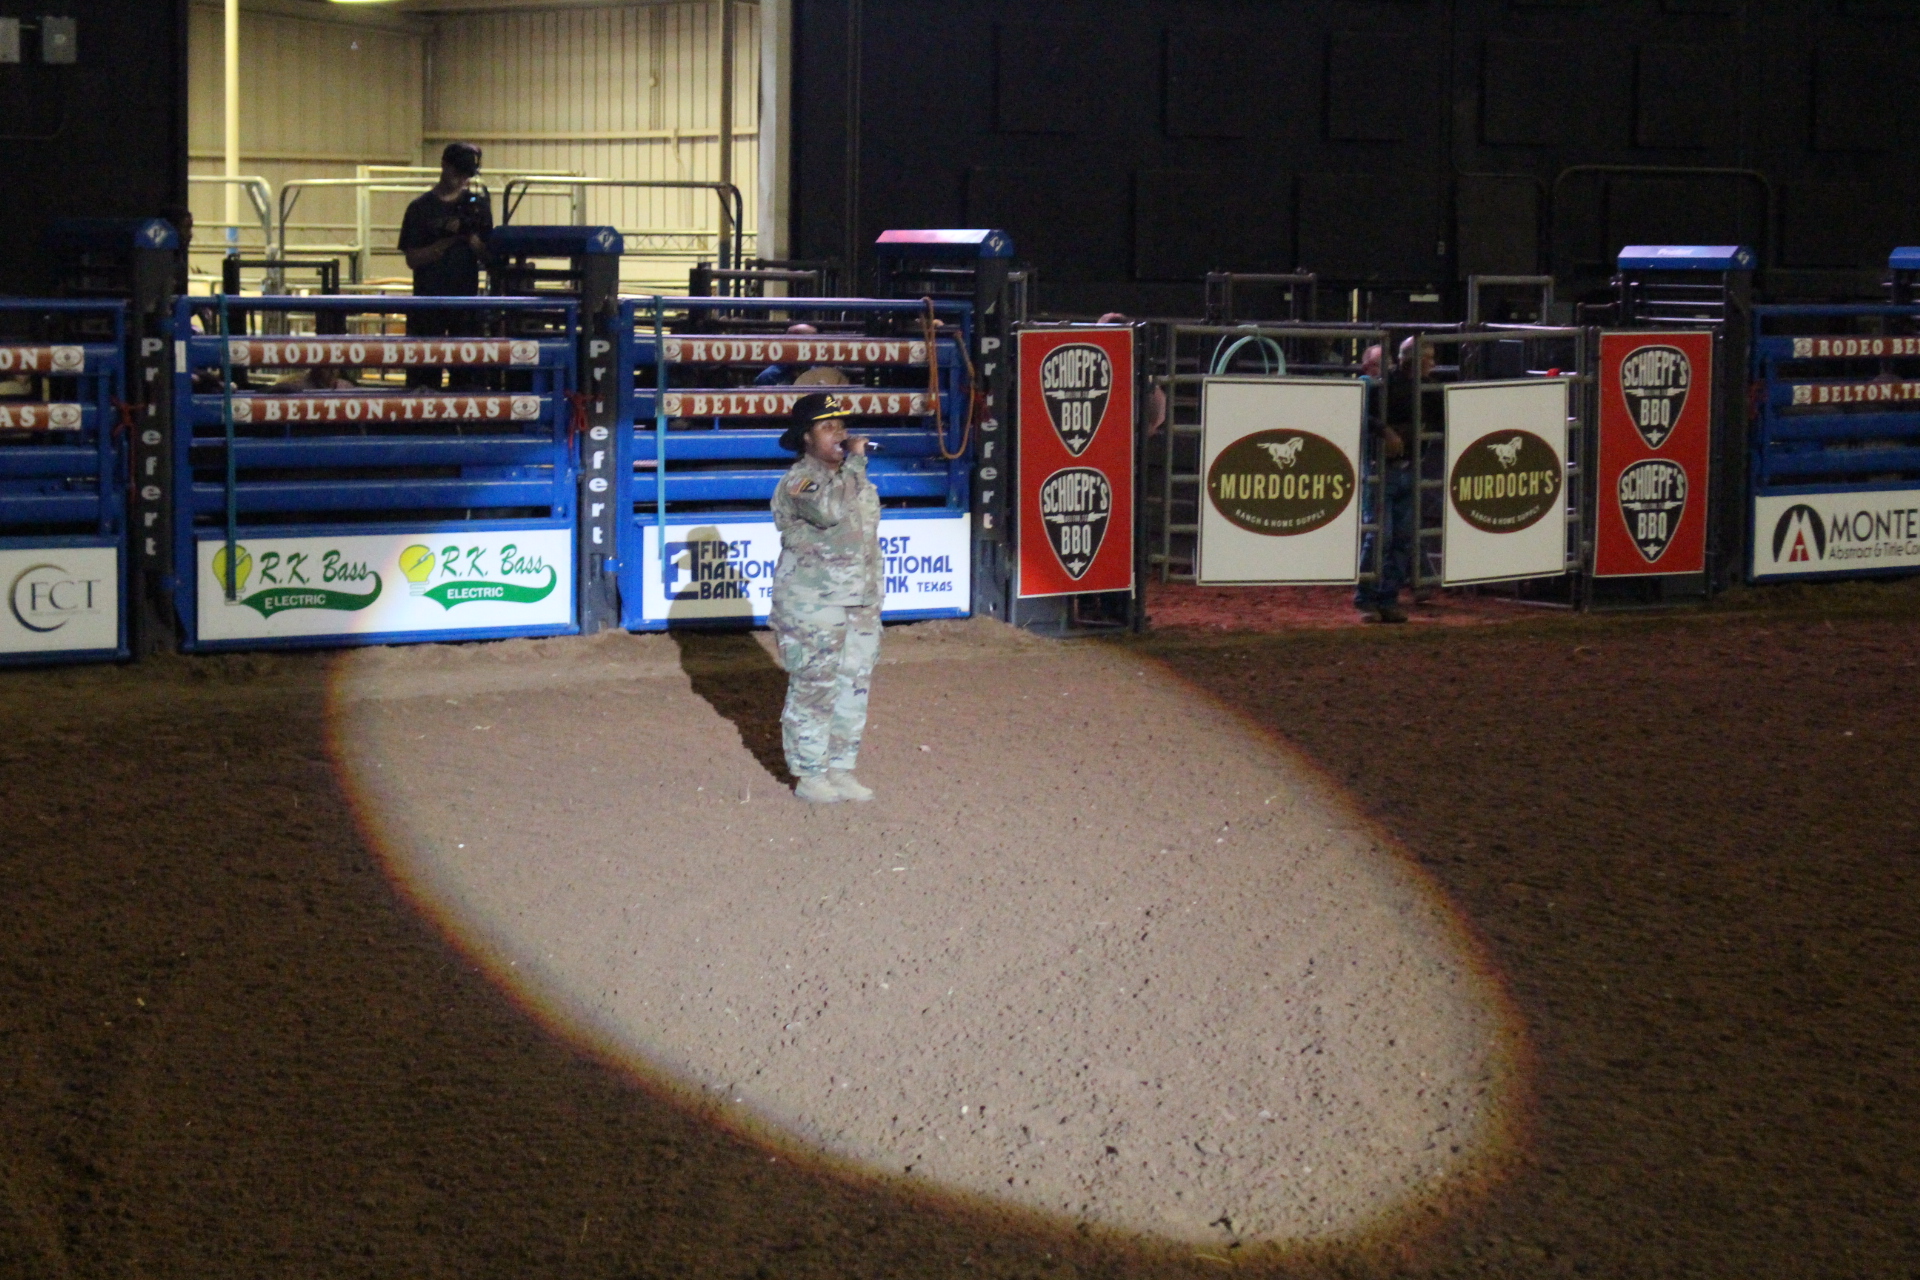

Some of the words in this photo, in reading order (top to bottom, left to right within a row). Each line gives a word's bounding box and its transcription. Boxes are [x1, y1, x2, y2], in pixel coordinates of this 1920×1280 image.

[263, 343, 366, 363] RODEO
[382, 341, 500, 362] BELTON
[693, 342, 783, 361] RODEO
[797, 342, 900, 361] BELTON
[1819, 339, 1884, 356] RODEO
[1044, 349, 1109, 389] SCHOEPF'S
[1624, 350, 1687, 387] SCHOEPF'S
[1061, 401, 1092, 433] BBQ
[1640, 399, 1670, 428] BBQ
[589, 340, 610, 544] Priefert
[1044, 473, 1108, 513] SCHOEPF'S
[1220, 473, 1343, 499] MURDOCH'S
[1459, 470, 1553, 501] MURDOCH'S
[1621, 464, 1684, 501] SCHOEPF'S
[1235, 508, 1261, 525] RANCH
[1271, 519, 1293, 528] HOME
[1296, 509, 1325, 526] SUPPLY
[1637, 512, 1667, 541] BBQ
[700, 540, 751, 559] FIRST
[879, 536, 910, 555] RST
[1061, 525, 1092, 556] BBQ
[1829, 545, 1873, 560] Abstract
[1883, 541, 1903, 557] Title
[322, 549, 369, 582] Bass
[500, 543, 543, 575] Bass
[700, 560, 775, 580] NATION
[883, 554, 953, 574] TIONAL
[447, 586, 504, 599] ELECTRIC
[700, 580, 749, 600] BANK
[884, 575, 909, 593] NK
[917, 581, 953, 593] TEXAS
[264, 593, 326, 609] ELECTRIC
